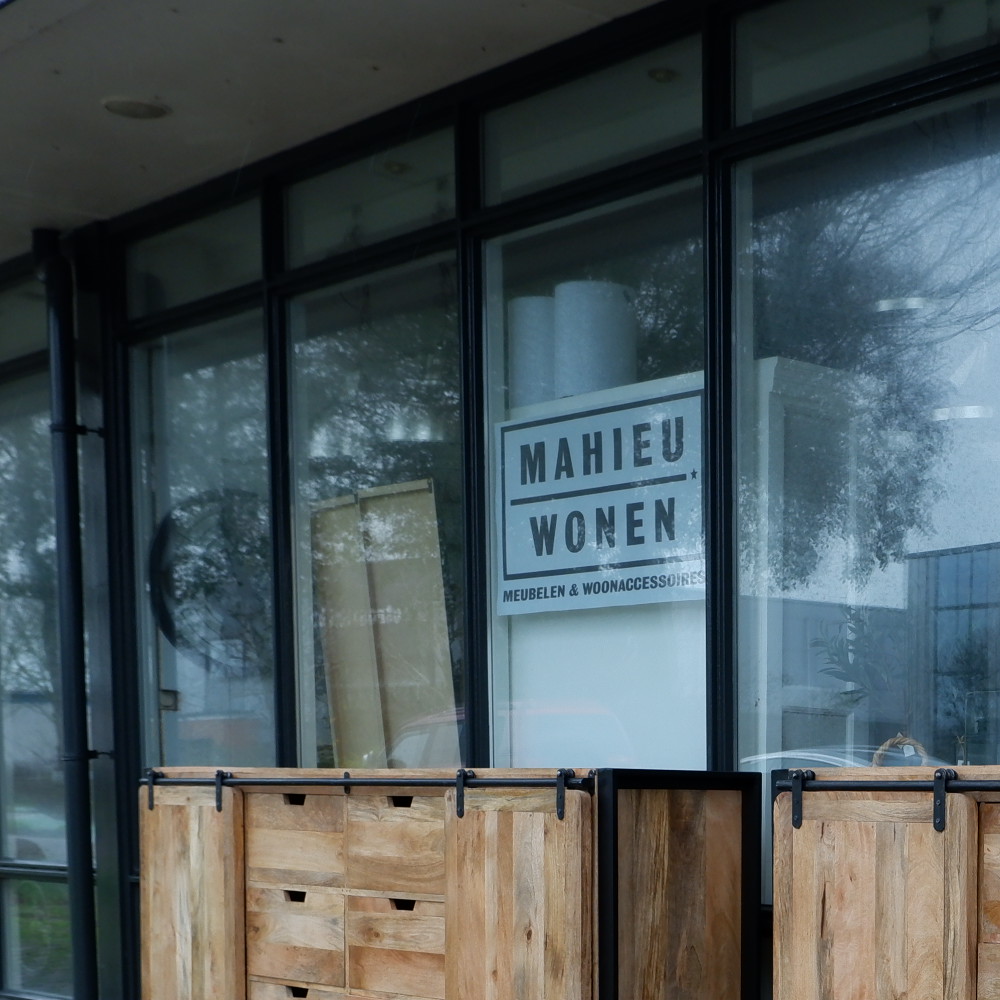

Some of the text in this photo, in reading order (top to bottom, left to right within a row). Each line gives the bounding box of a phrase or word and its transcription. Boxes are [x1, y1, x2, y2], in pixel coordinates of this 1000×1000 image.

[520, 416, 684, 486] MAHIEU
[530, 497, 675, 556] WONEN
[503, 570, 705, 602] MEUBELEN & WOONACCESSOIRES
